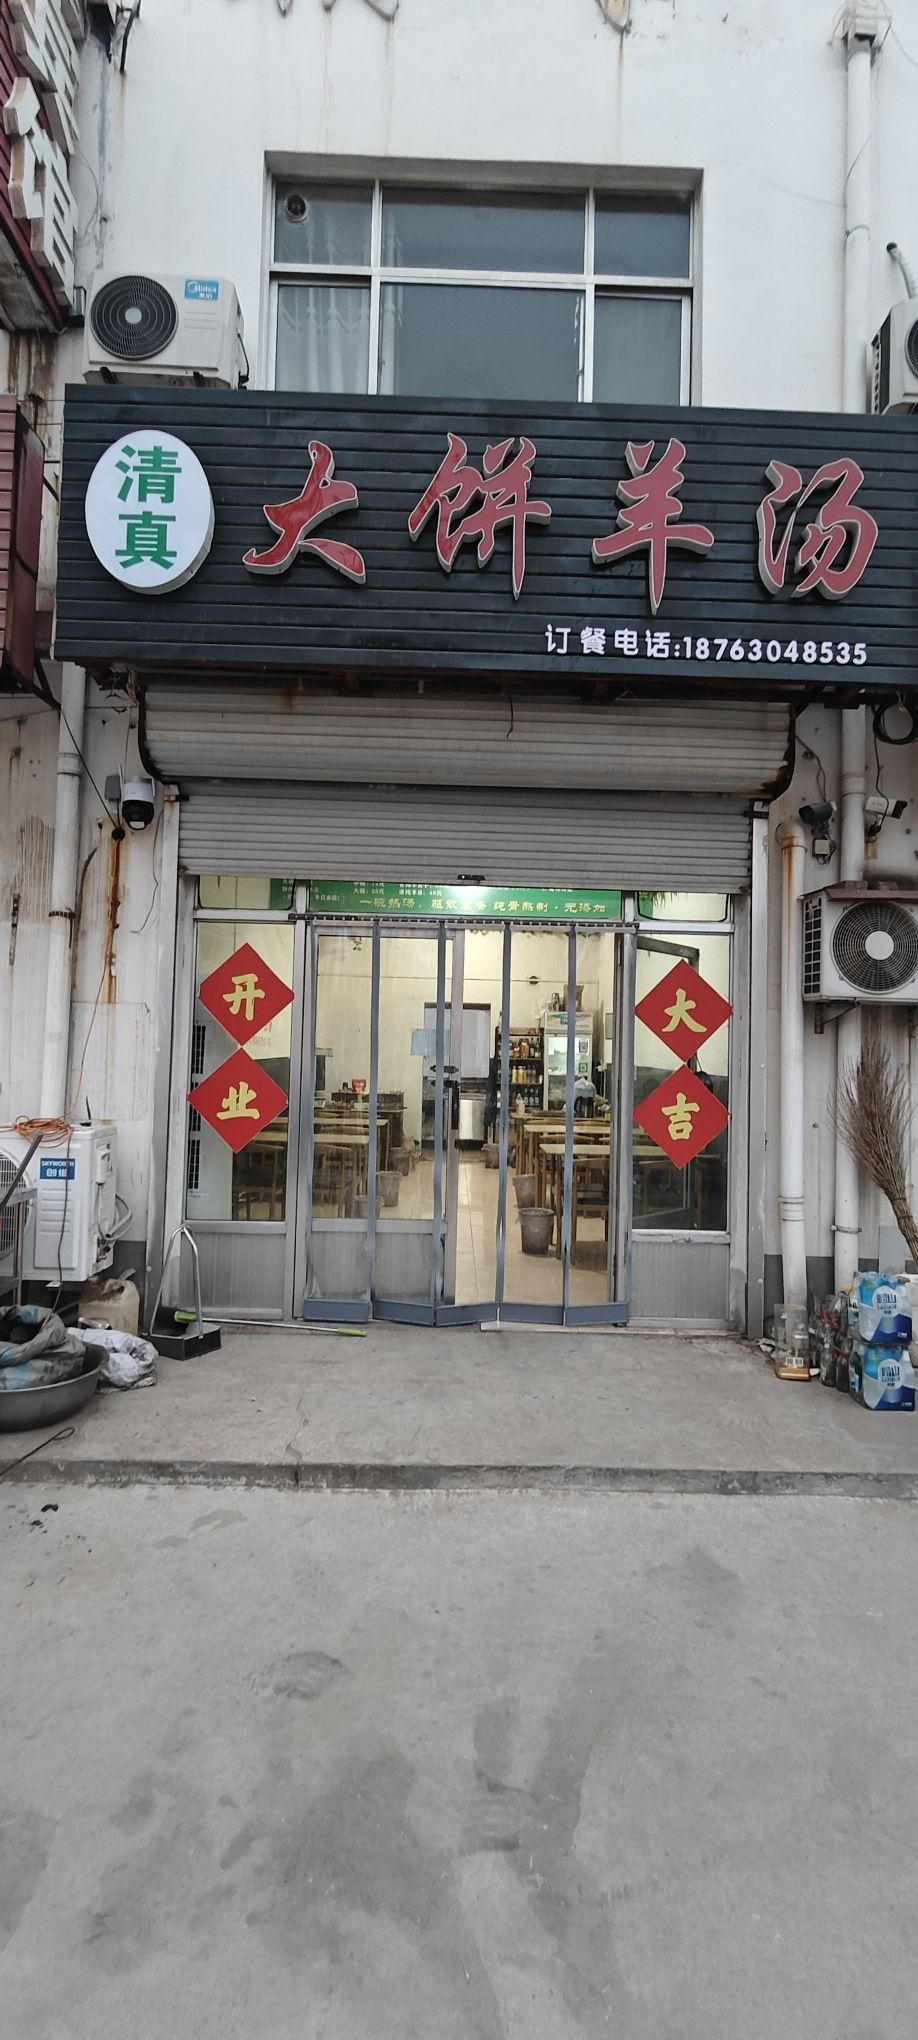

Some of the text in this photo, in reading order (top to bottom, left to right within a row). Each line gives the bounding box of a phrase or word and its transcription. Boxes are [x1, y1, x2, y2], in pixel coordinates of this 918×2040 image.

[114, 445, 182, 570] 清真
[242, 432, 879, 616] 大饼羊汤
